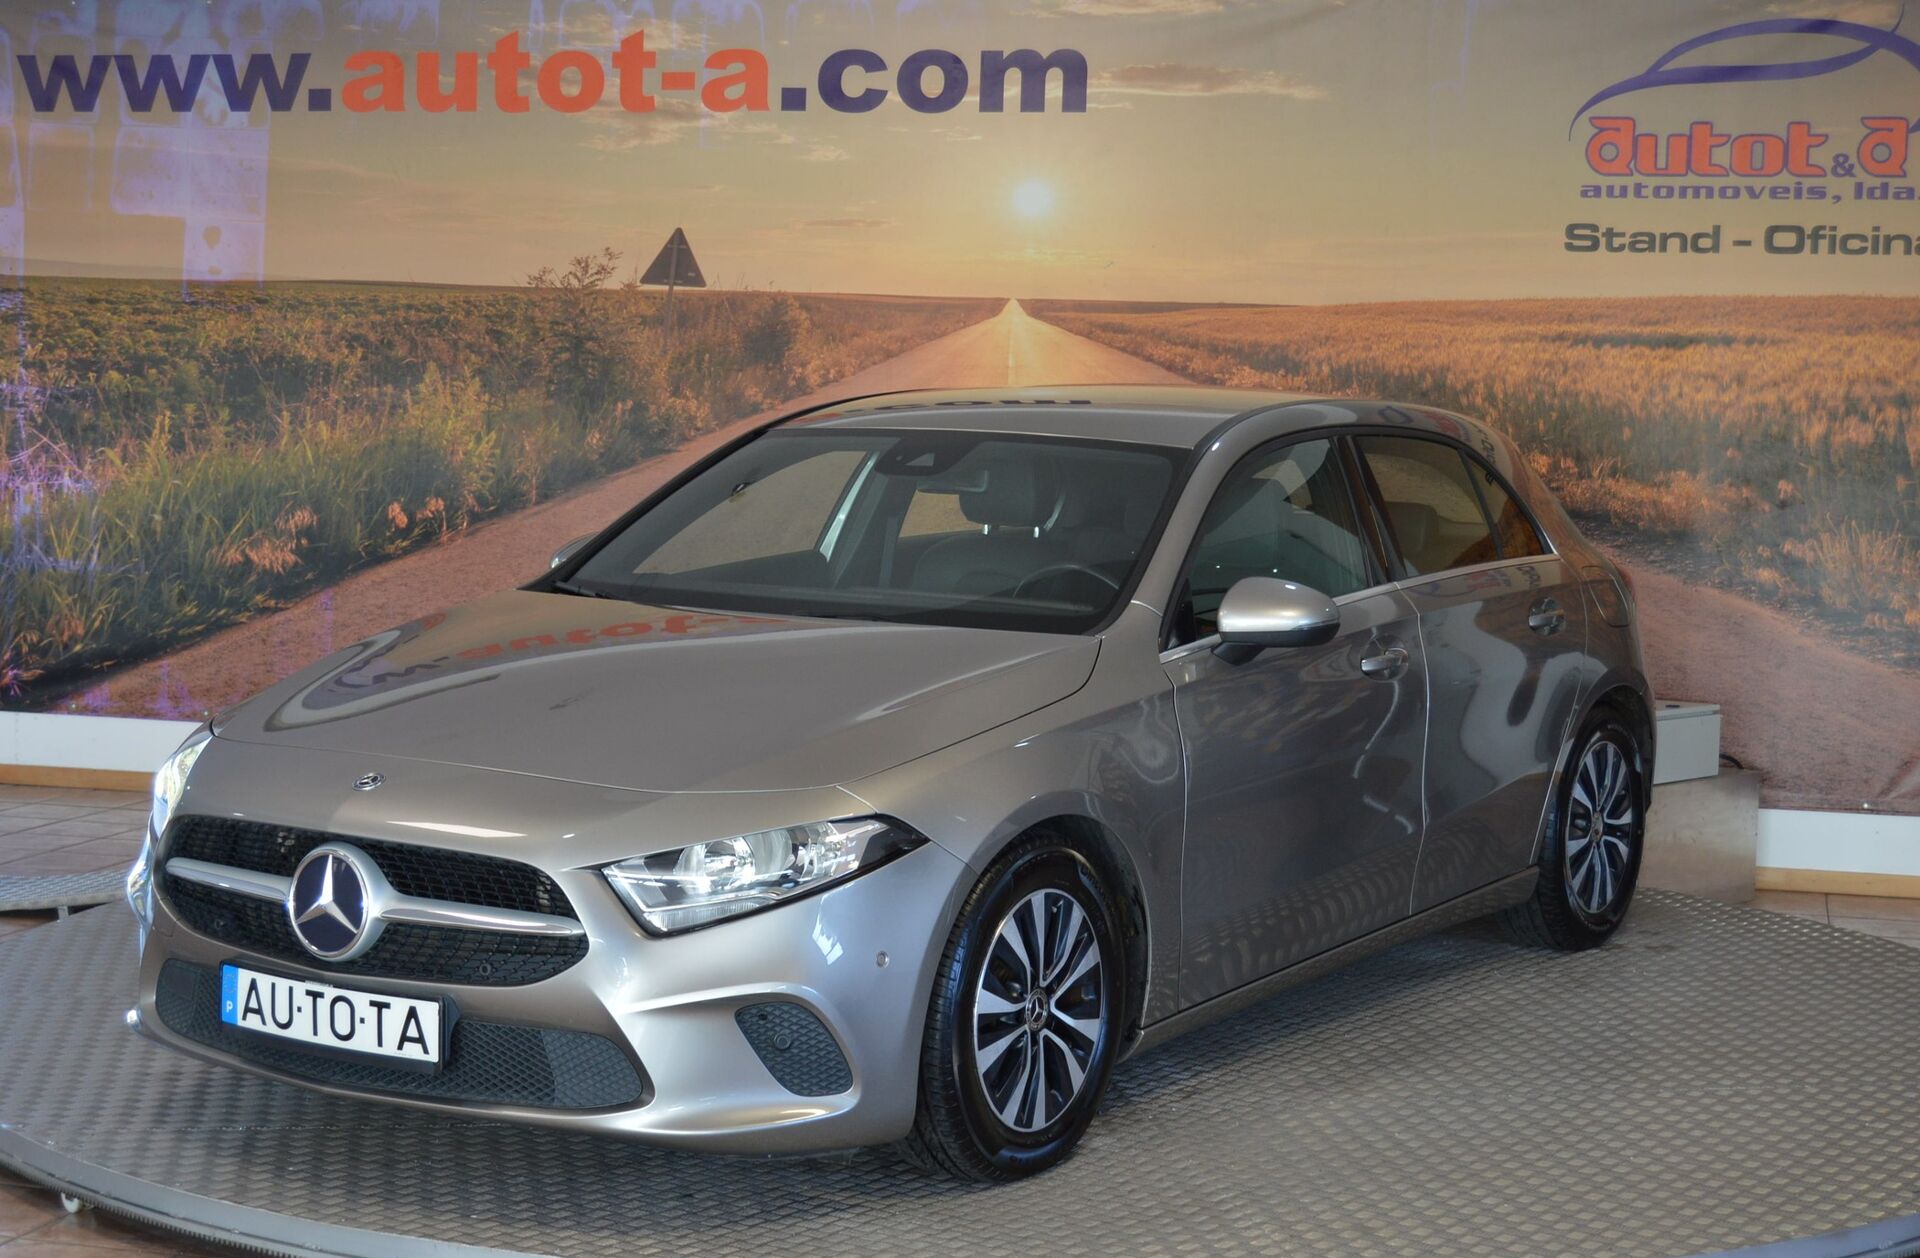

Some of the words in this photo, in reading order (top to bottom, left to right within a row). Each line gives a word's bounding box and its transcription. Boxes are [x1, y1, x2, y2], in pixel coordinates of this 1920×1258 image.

[17, 30, 1088, 114] www.autot-a.com
[1580, 181, 1842, 204] automoveis,
[1854, 181, 1920, 201] lda
[1564, 223, 1721, 254] Stand
[1764, 224, 1920, 255] Oficin
[226, 1001, 233, 1013] P
